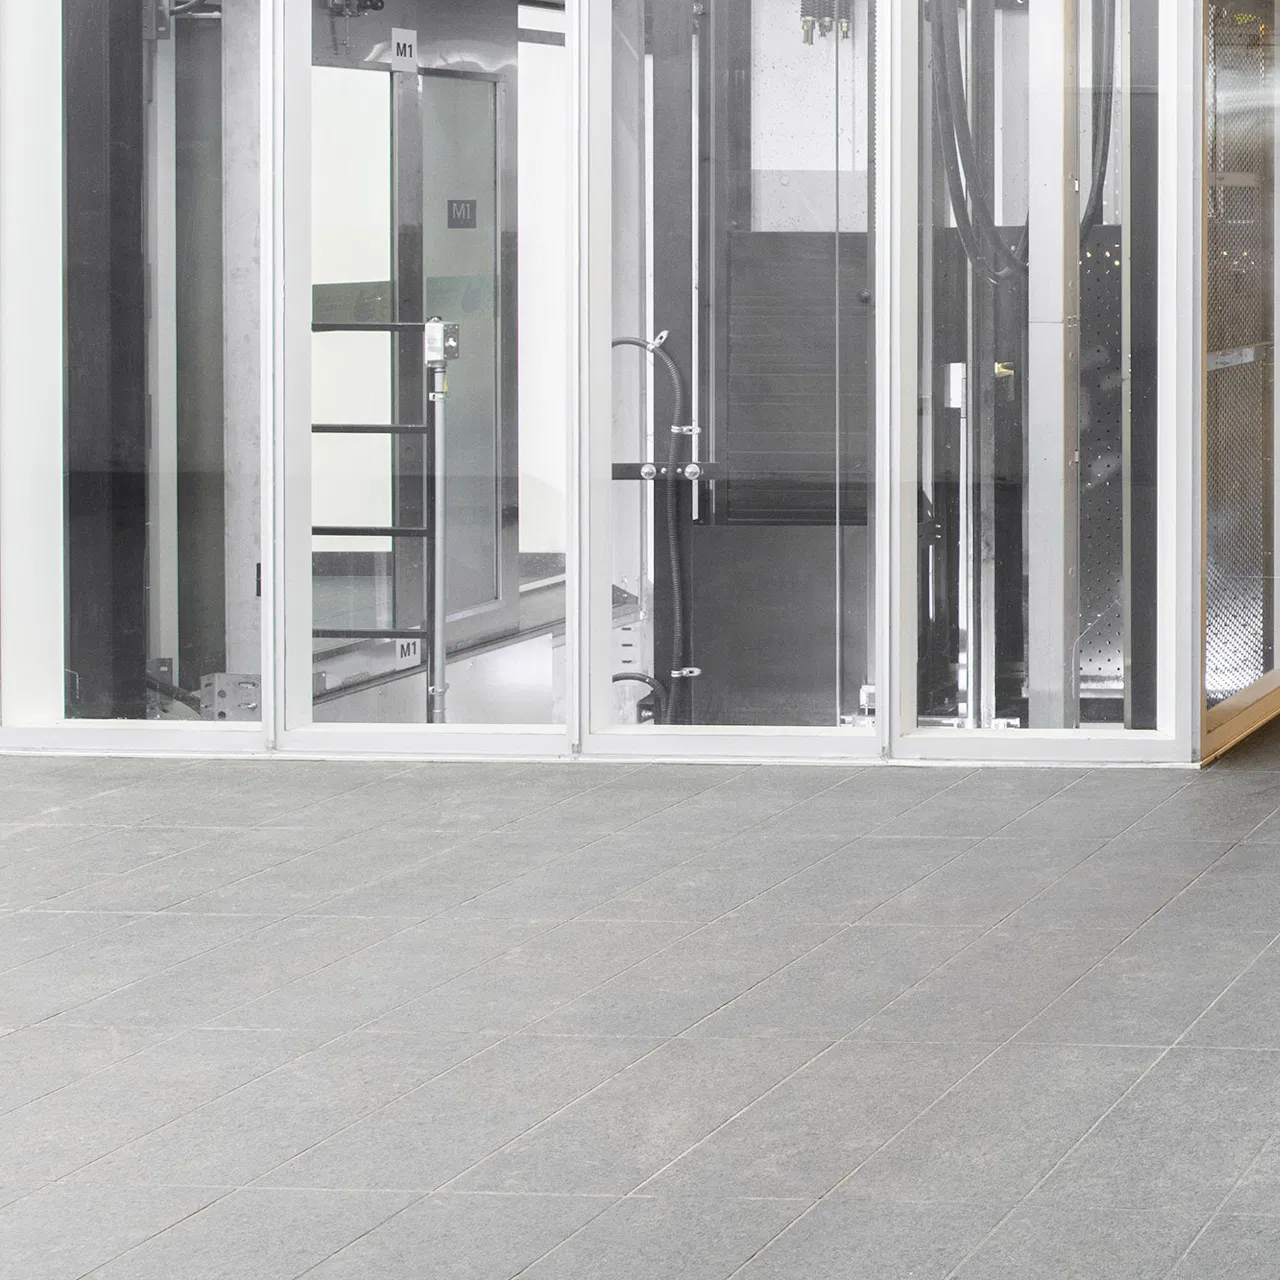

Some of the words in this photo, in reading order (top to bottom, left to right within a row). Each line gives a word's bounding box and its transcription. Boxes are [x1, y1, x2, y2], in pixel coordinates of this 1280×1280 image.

[396, 42, 413, 58] M1
[452, 202, 470, 219] M1
[400, 641, 417, 659] M1
